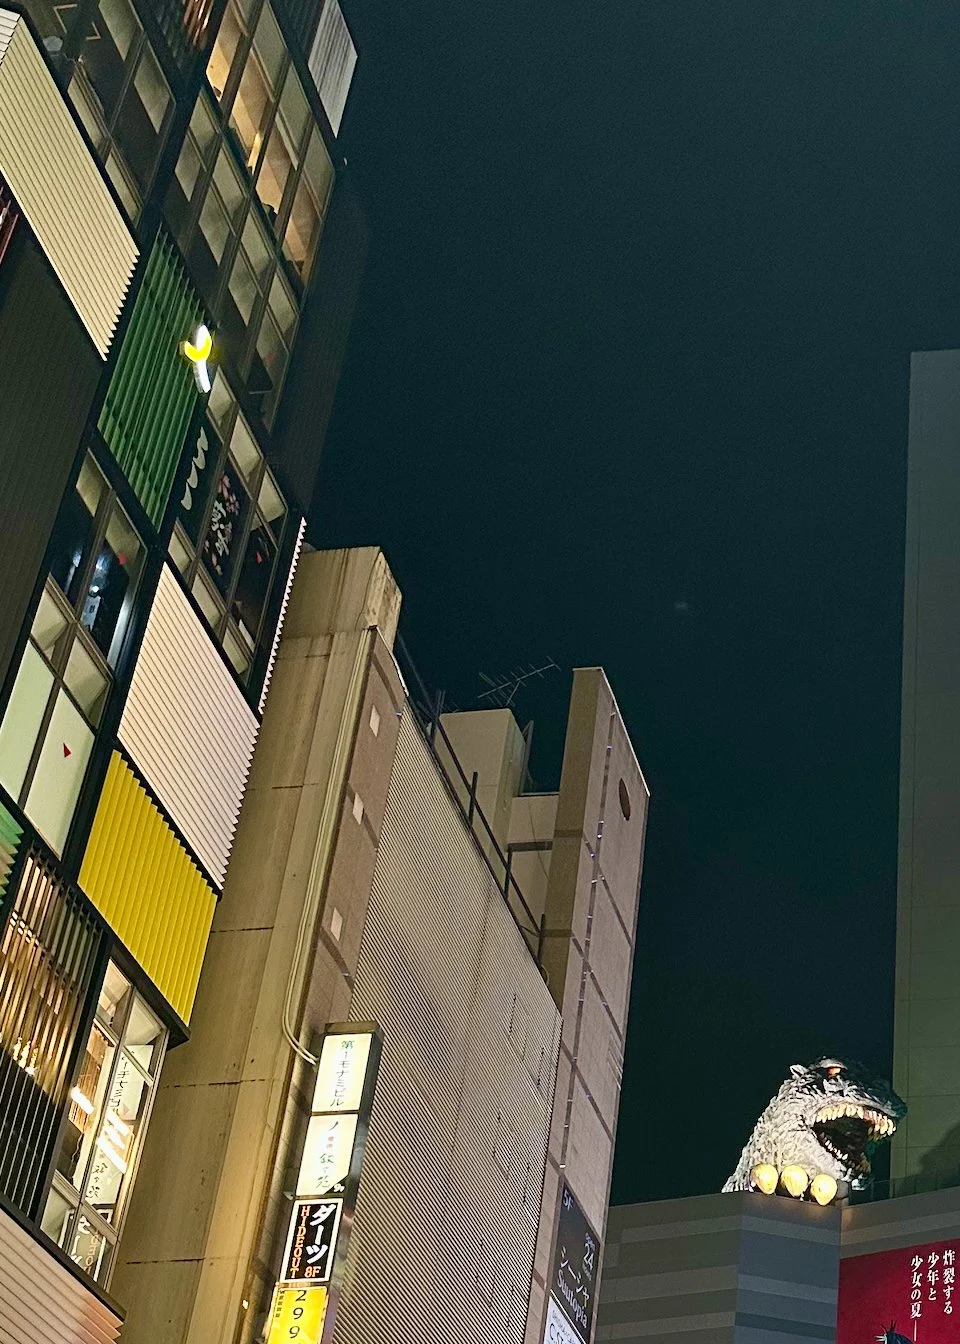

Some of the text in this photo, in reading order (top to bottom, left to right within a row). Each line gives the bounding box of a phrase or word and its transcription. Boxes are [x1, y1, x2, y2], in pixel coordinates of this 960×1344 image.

[290, 1206, 311, 1279] HIDEOUT
[306, 1204, 336, 1264] ダーツ
[304, 1266, 321, 1279] 8F
[927, 1251, 940, 1301] 少年と
[942, 1249, 956, 1314] 炸裂する
